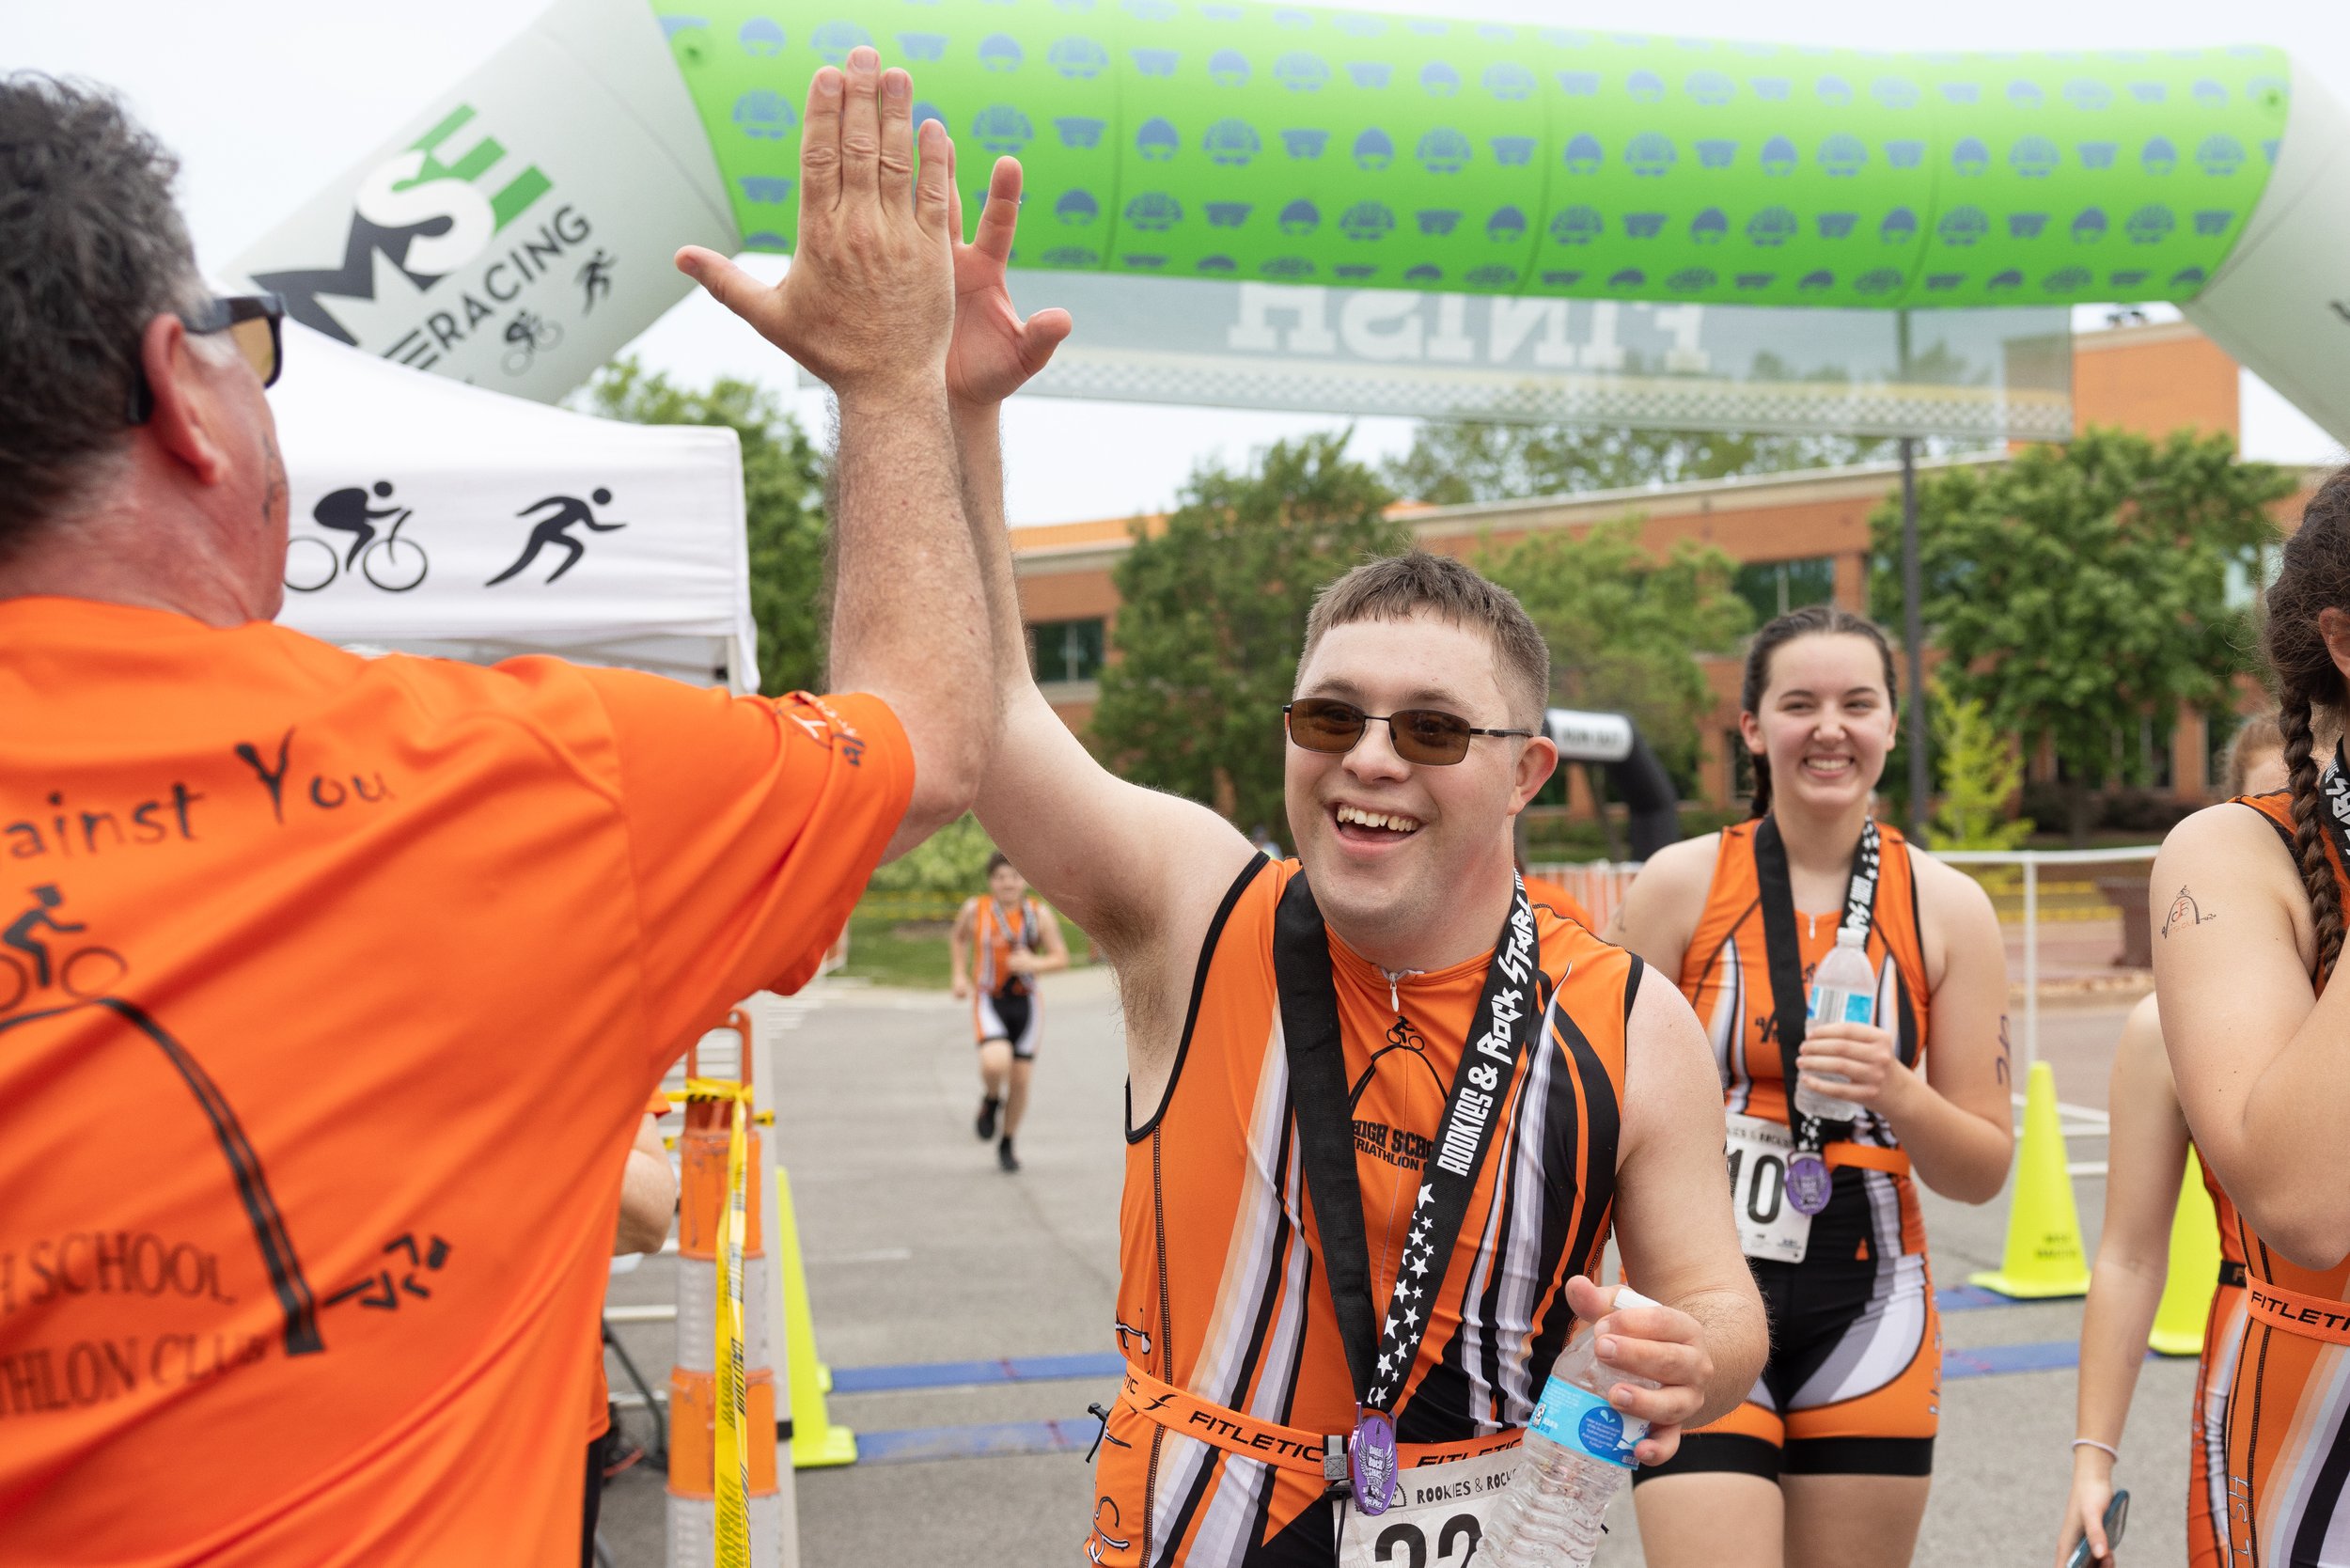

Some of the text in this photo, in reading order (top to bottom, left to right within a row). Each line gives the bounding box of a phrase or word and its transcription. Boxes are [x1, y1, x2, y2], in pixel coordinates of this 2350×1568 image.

[249, 102, 555, 346] MSE
[1437, 1087, 1495, 1177] ROOKIES
[1467, 1062, 1498, 1091] &
[30, 1231, 236, 1307] SCHOOL
[0, 1341, 137, 1417] HLON
[1188, 1410, 1324, 1464] FITLETIC
[1417, 1481, 1471, 1504] ROOKIES
[1475, 1477, 1482, 1493] &
